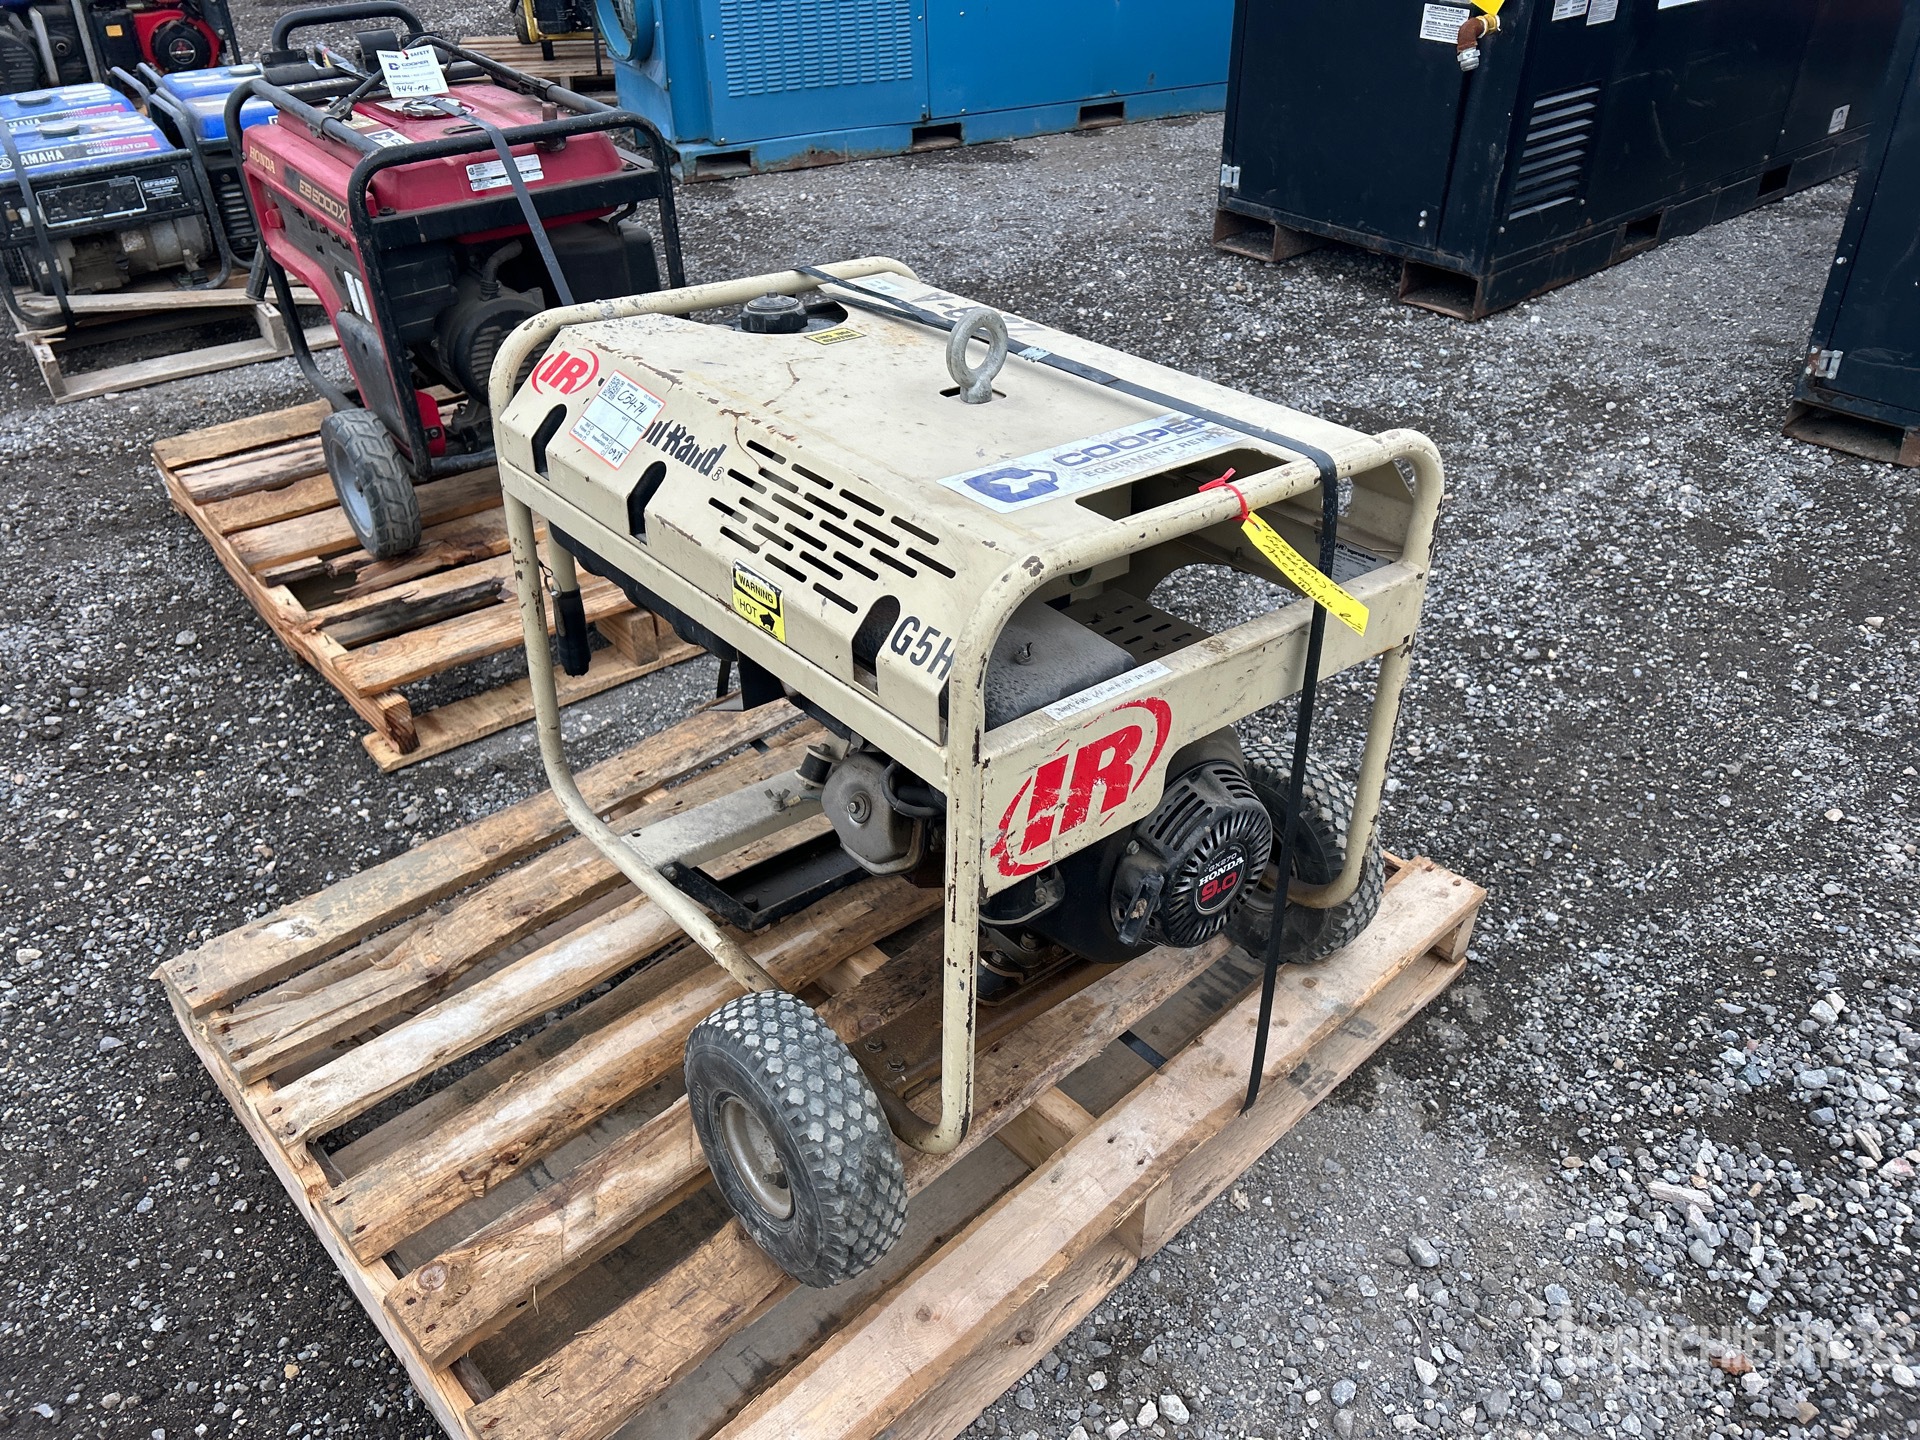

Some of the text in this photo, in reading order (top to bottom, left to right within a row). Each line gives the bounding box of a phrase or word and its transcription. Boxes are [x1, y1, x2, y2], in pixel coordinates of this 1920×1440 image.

[20, 149, 65, 166] AMAHA
[249, 146, 276, 174] HONDA
[538, 350, 590, 396] IR
[1083, 446, 1175, 478] EQUIPMENT
[738, 572, 774, 605] WARNING
[739, 599, 758, 618] HOT
[1019, 725, 1143, 856] IR
[1199, 856, 1244, 887] HONDA
[1208, 852, 1237, 872] GX270
[1201, 871, 1237, 903] 9.0
